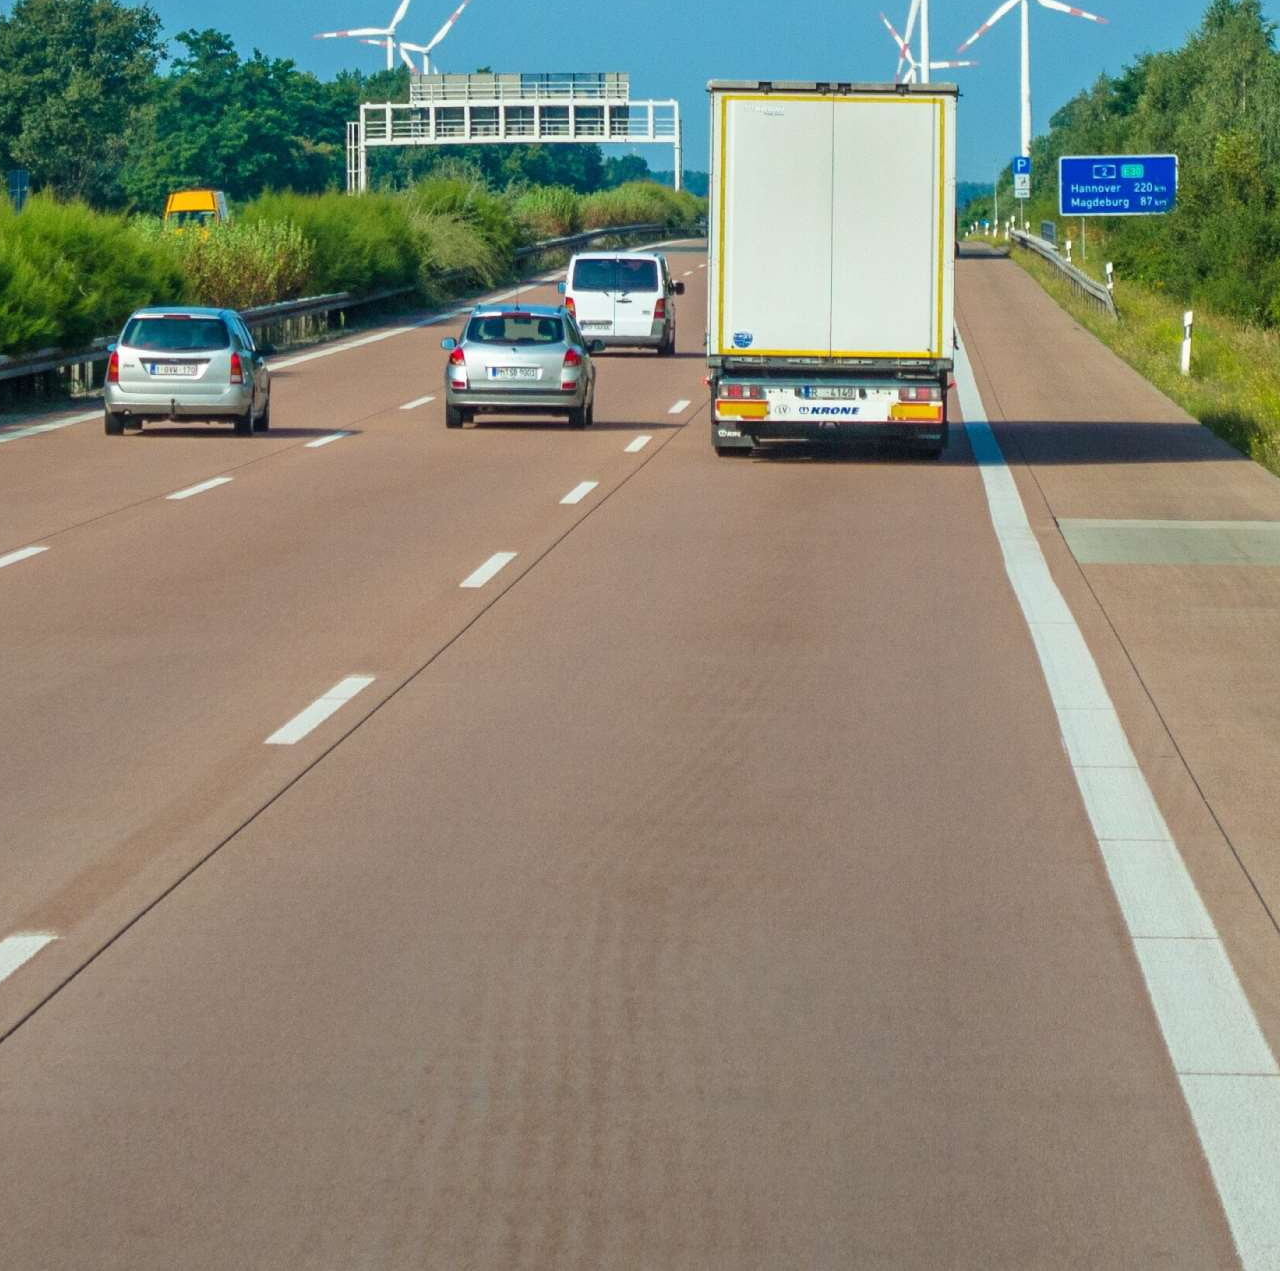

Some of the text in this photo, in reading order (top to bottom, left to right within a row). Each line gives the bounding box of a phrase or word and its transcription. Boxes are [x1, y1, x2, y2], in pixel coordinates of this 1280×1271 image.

[1017, 159, 1026, 172] P
[1071, 184, 1121, 193] Hannover
[1134, 182, 1153, 193] 220
[1071, 197, 1130, 209] Magdeburg
[1140, 196, 1153, 206] 87
[811, 407, 860, 415] KRONE
